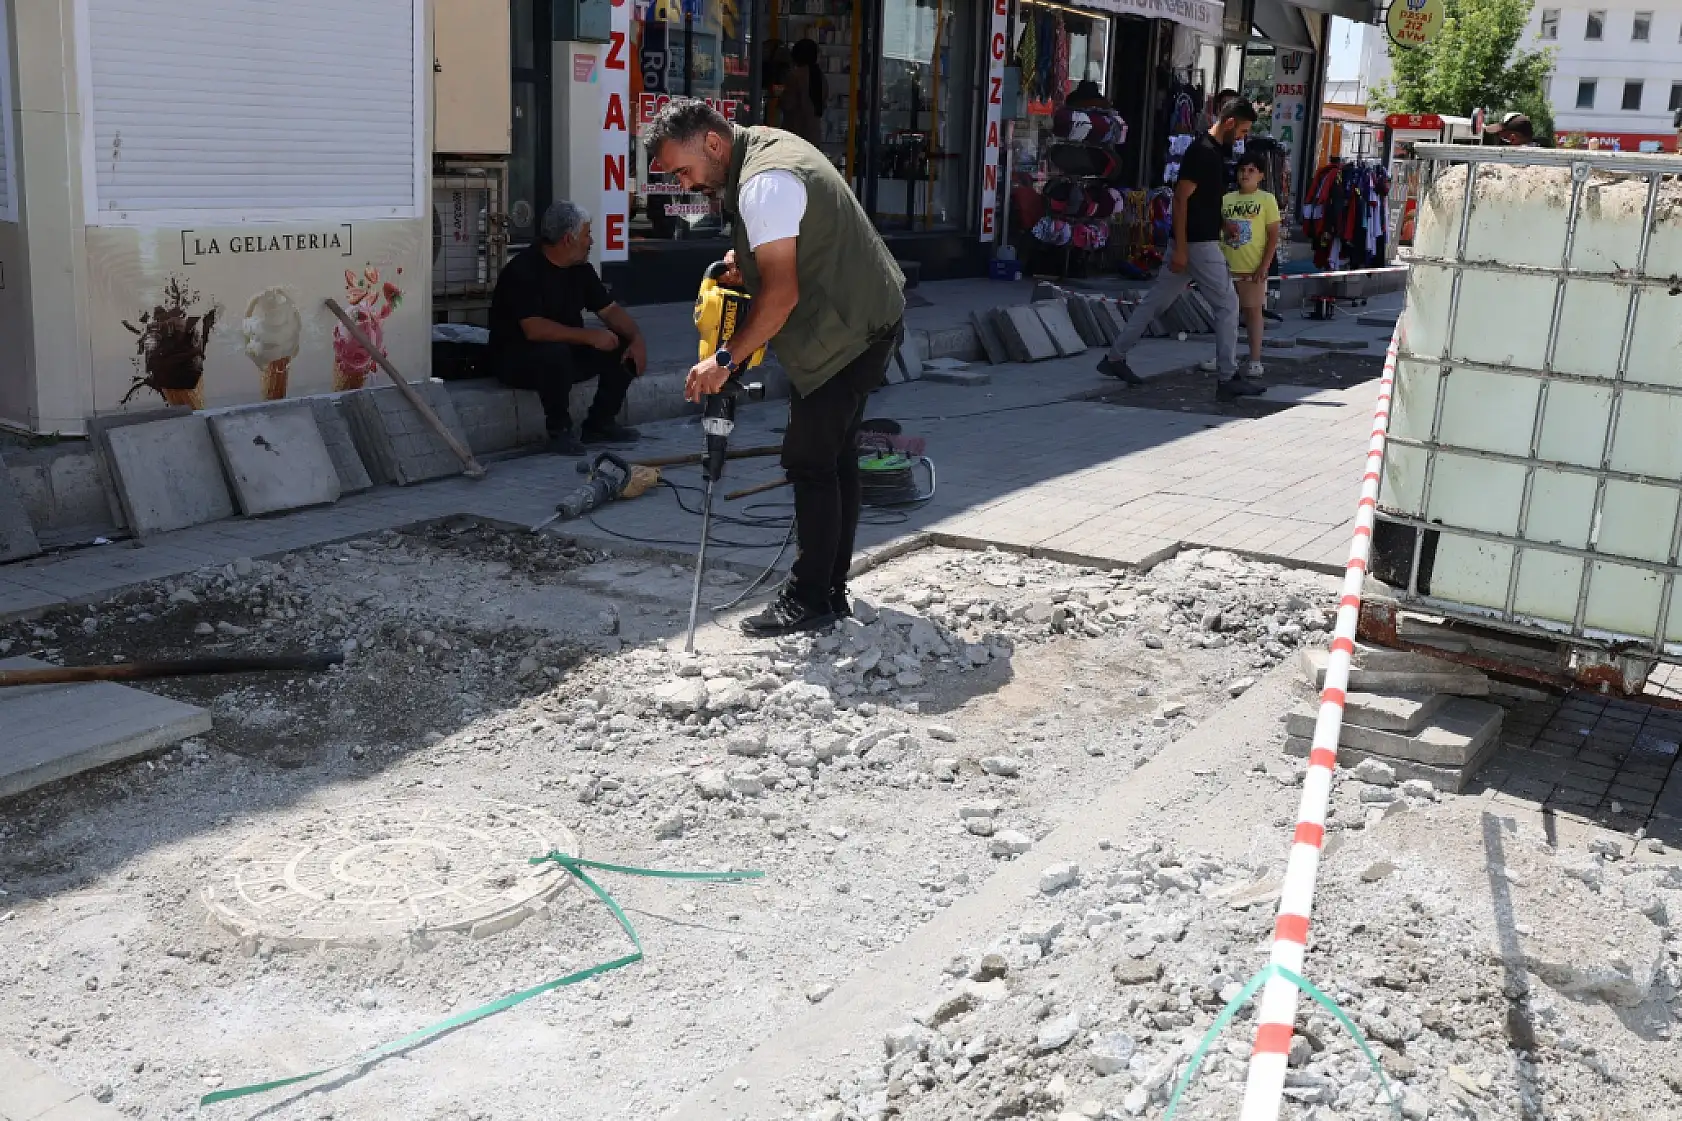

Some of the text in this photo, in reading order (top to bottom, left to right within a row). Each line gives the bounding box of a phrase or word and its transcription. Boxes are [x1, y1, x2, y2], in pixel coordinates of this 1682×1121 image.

[602, 0, 626, 250] ZANE
[195, 233, 341, 255] LA GELATERIA
